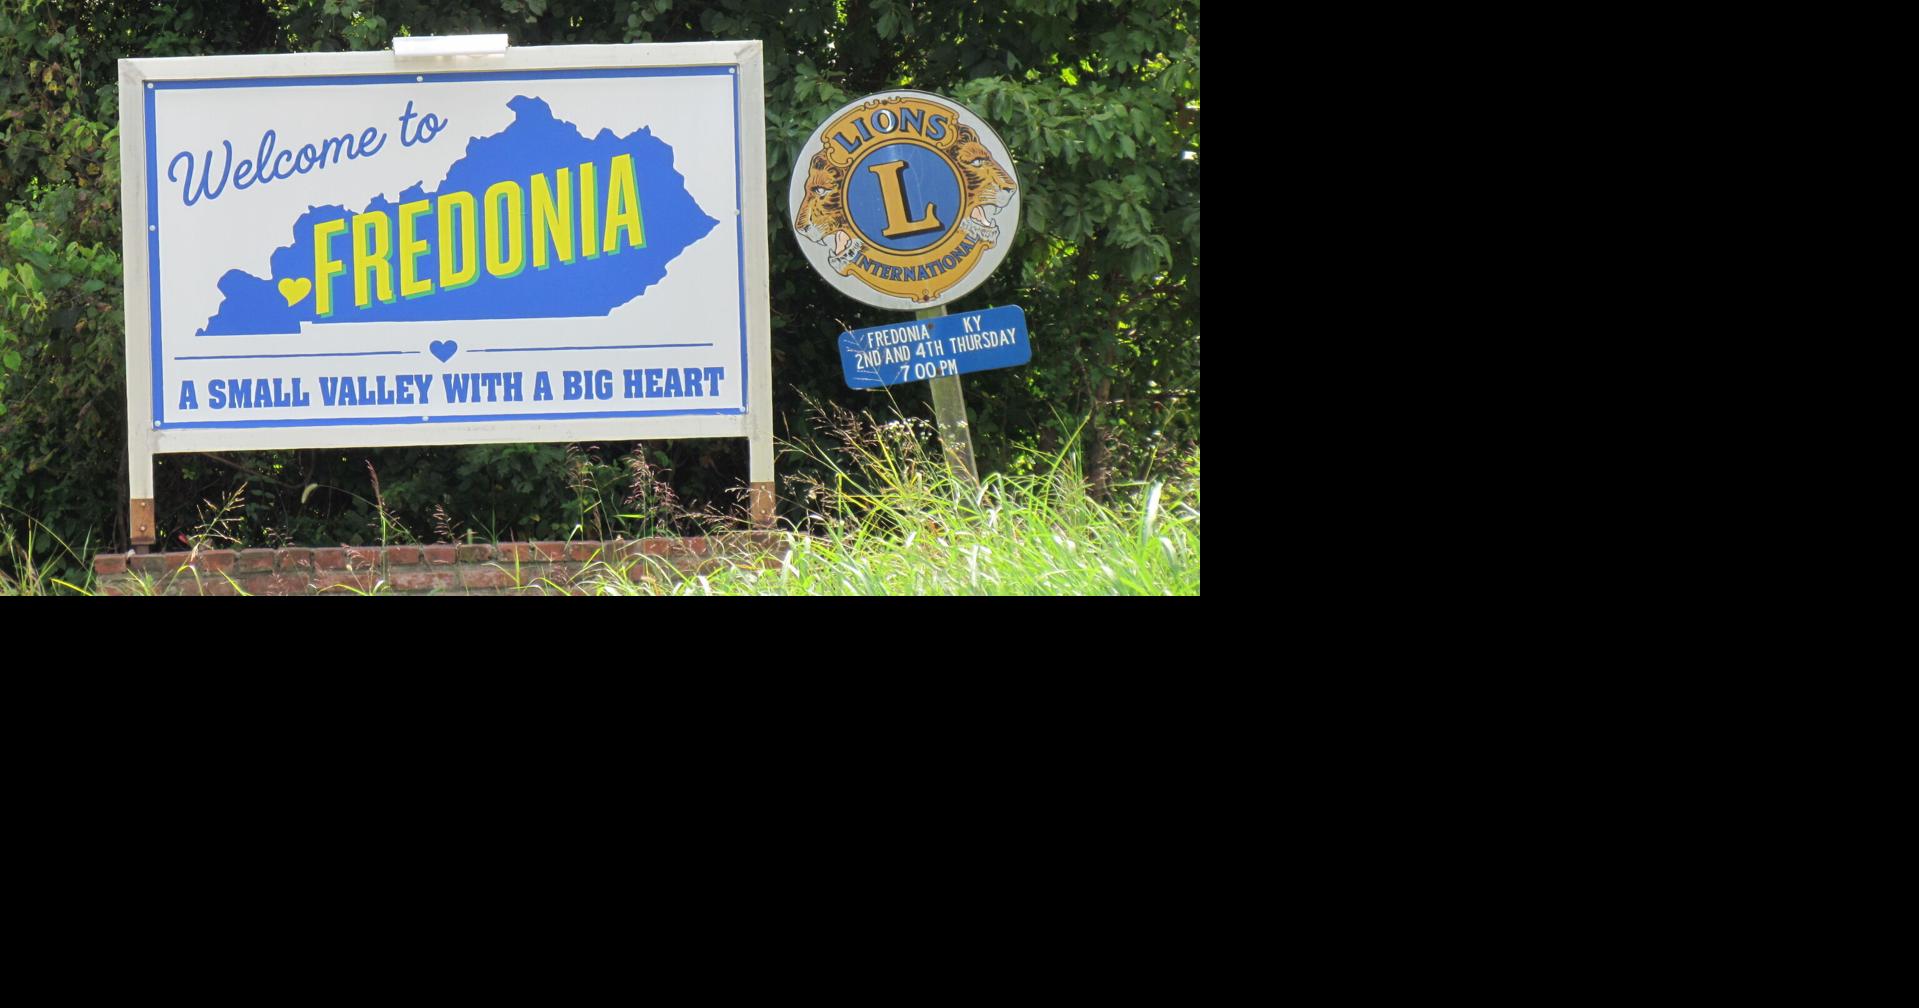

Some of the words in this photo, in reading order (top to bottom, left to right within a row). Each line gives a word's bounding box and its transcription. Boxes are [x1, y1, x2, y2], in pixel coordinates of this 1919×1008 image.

[168, 126, 387, 206] Welcome
[398, 100, 449, 143] to
[832, 107, 949, 154] LIONS
[869, 160, 945, 240] L
[312, 153, 647, 318] FREDONIA
[851, 232, 981, 282] INTERNATIONAL
[855, 350, 881, 369] 2ND
[885, 345, 911, 364] AND
[915, 340, 944, 359] 4TH
[949, 328, 1016, 354] THURSDAY
[867, 324, 930, 348] FREDONIA
[963, 315, 981, 333] KY
[179, 380, 199, 410] A
[208, 376, 310, 409] SMALL
[319, 373, 433, 406] VALLEY
[443, 371, 524, 404] WITH
[532, 370, 554, 402] A
[563, 368, 613, 400] BIG
[622, 366, 725, 399] HEART
[915, 363, 937, 380] 00
[940, 359, 958, 376] PM
